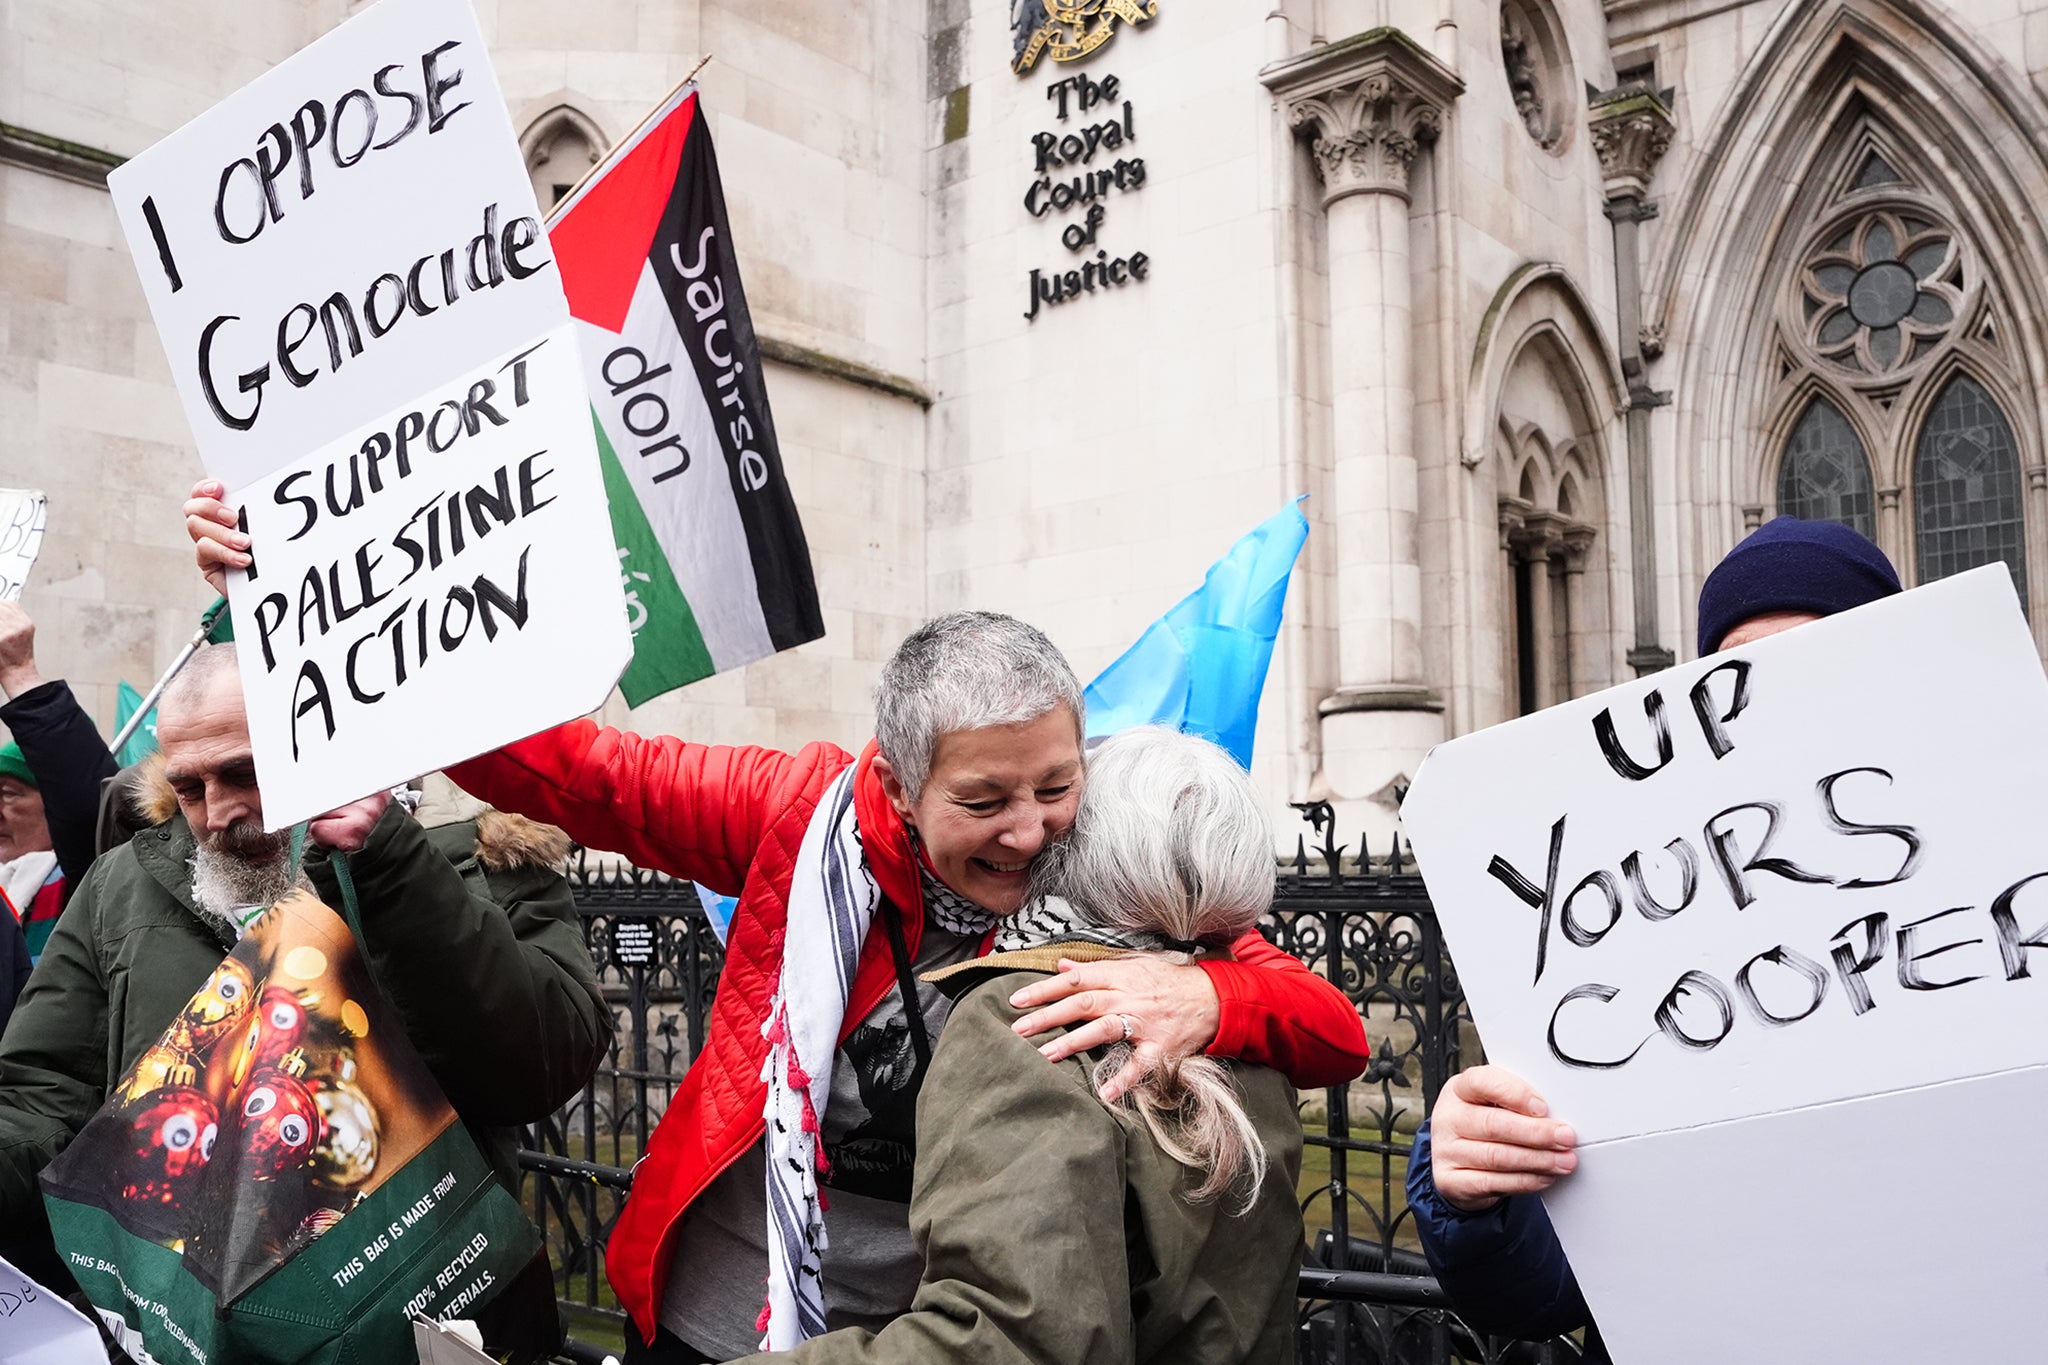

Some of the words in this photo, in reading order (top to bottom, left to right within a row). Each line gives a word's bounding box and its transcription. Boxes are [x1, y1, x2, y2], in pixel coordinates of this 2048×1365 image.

[1031, 100, 1134, 172] Royal
[1047, 73, 1119, 119] The
[142, 195, 182, 293] I
[214, 40, 472, 244] OPPOSE
[1024, 158, 1146, 217] Courts
[1024, 250, 1148, 319] Justice
[1062, 203, 1104, 250] of
[198, 202, 551, 430] Genocide
[238, 504, 258, 582] I
[274, 339, 549, 541] SUPPORT
[602, 346, 690, 484] don
[255, 449, 558, 673] PALESTINE
[291, 544, 531, 762] ACTION
[1592, 659, 1755, 781] UP
[1487, 767, 1928, 988] YOURS
[70, 1252, 95, 1268] THIS
[97, 1259, 116, 1275] BAG
[332, 1257, 364, 1288] THIS
[363, 1234, 389, 1262] BAG
[388, 1222, 404, 1240] IS
[401, 1194, 436, 1228] MADE
[432, 1171, 457, 1201] FROM
[402, 1285, 436, 1321] 100%
[435, 1232, 488, 1291] RECYCLED
[433, 1270, 496, 1325] ATERIALS.
